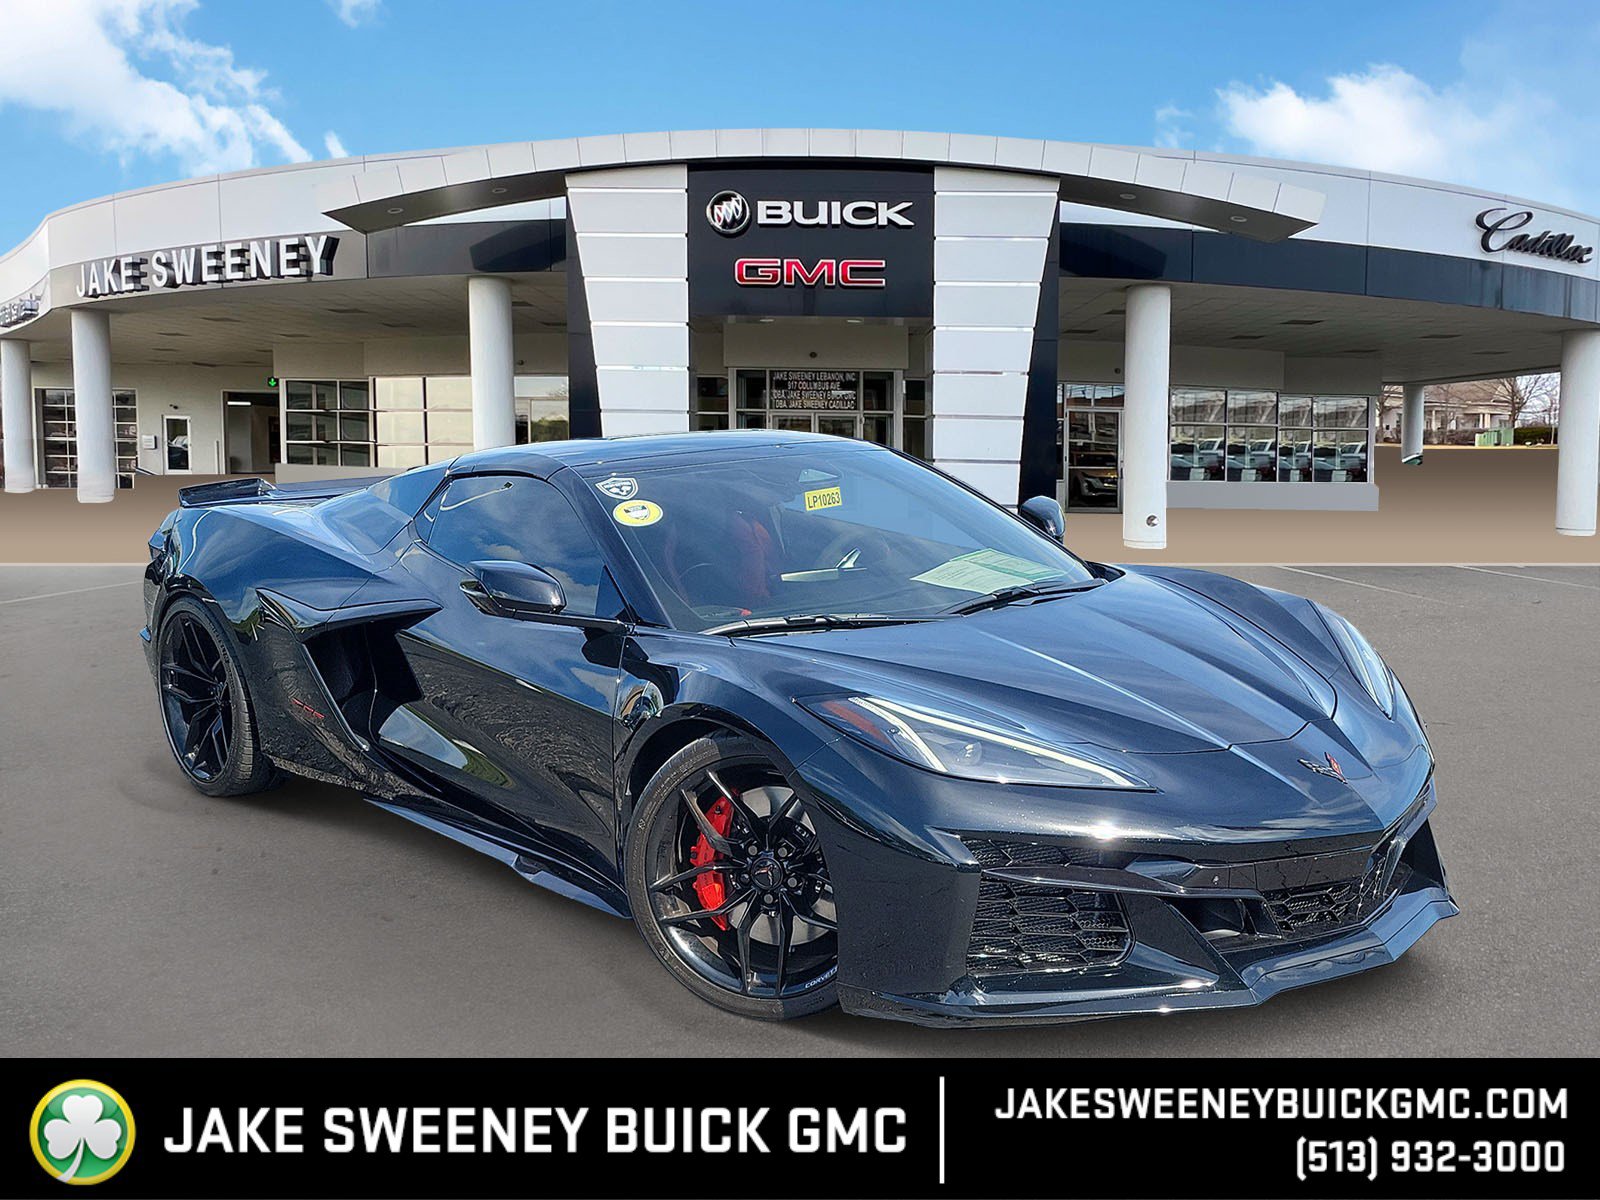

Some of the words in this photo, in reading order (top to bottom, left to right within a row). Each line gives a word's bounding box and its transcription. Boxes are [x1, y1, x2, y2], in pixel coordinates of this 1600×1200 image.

[757, 200, 915, 226] BUICK
[1475, 207, 1593, 264] Cadillac
[76, 256, 141, 298] JAKE
[151, 235, 331, 288] SWEENEY
[735, 258, 886, 286] GMC
[773, 371, 788, 381] JAKE
[788, 371, 816, 381] SWEENEY
[787, 380, 797, 390] 917
[801, 390, 827, 400] SWEENEY
[802, 400, 828, 409] SWEENEY
[828, 400, 856, 409] CADILLAC
[807, 491, 841, 509] LP10263
